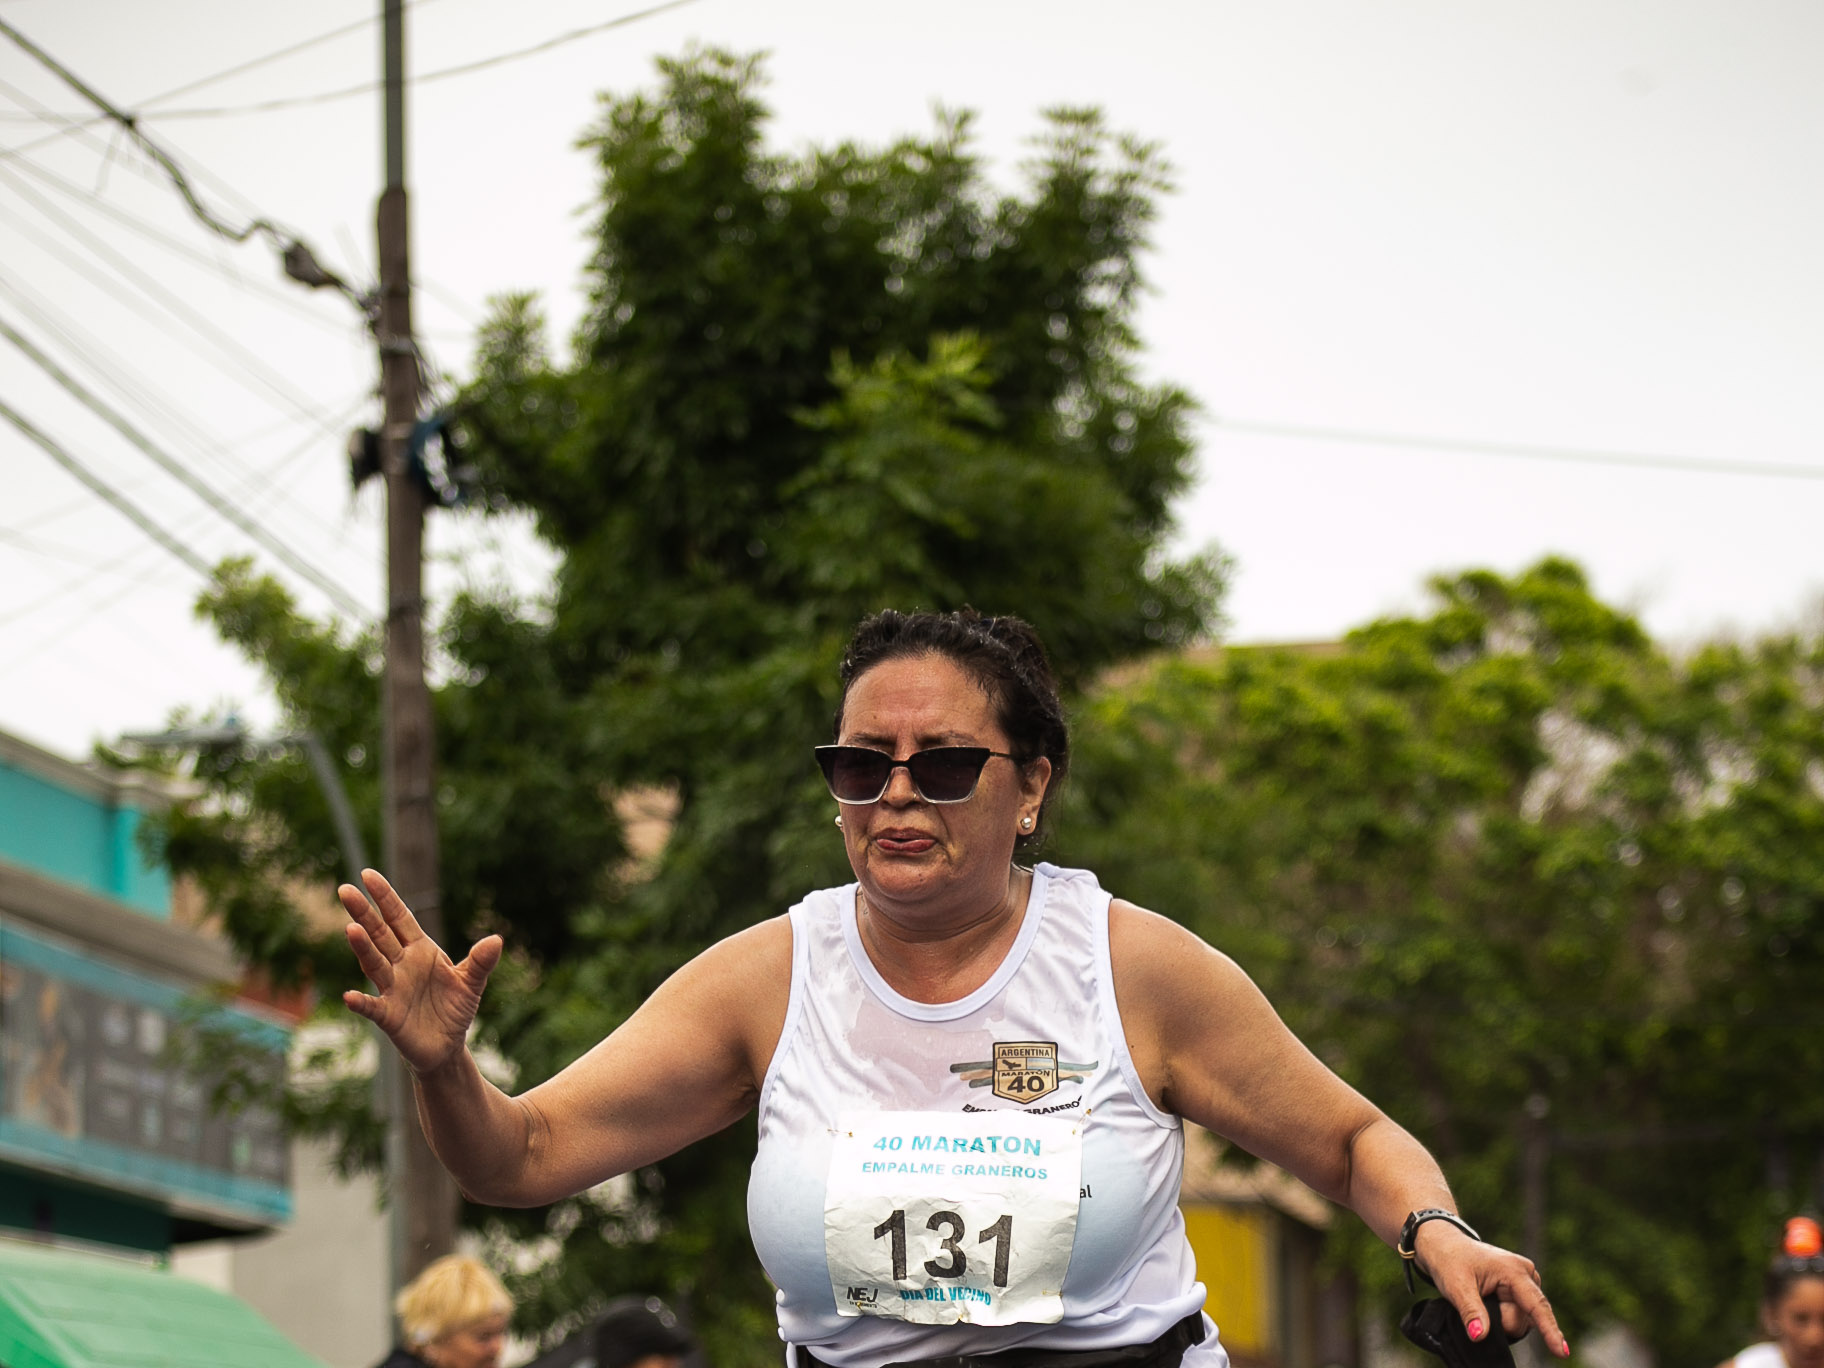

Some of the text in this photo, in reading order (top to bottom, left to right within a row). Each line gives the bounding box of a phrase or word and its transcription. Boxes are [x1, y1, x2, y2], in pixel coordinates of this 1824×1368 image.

[1001, 1048, 1050, 1057] ARGENTINA
[1007, 1076, 1045, 1093] 40
[873, 1135, 1041, 1157] 40 MARATON
[862, 1161, 1048, 1180] EMPALME GRANEROS
[873, 1210, 1013, 1287] 131
[846, 1286, 879, 1303] NEJ
[900, 1286, 992, 1306] DIA DEL VECINO
